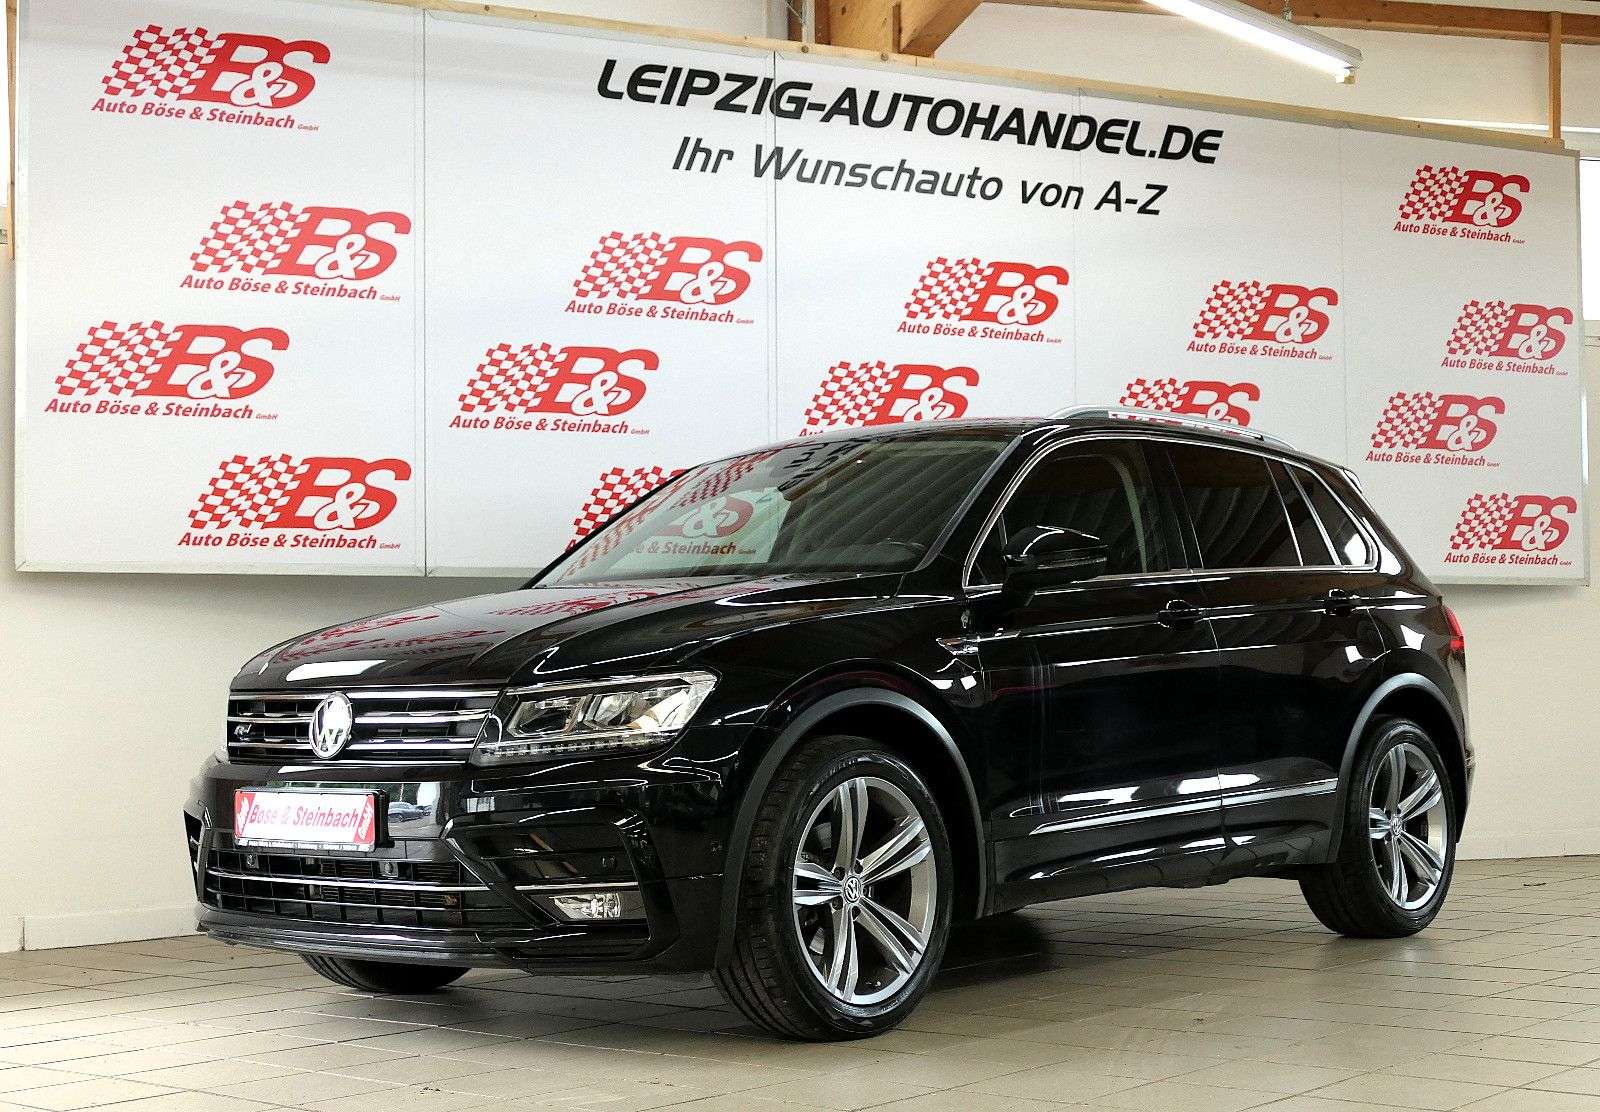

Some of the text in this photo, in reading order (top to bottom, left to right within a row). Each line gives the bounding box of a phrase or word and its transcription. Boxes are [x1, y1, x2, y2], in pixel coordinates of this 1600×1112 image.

[91, 98, 137, 113] Auto
[141, 102, 185, 118] Böse
[189, 107, 203, 120] &
[207, 108, 295, 128] Steinbach
[596, 59, 1223, 165] LEIPZIG-AUTOHANDEL.DE
[672, 136, 1168, 215] Ihr Wunschauto von A-Z
[1393, 221, 1420, 233] Auto
[1422, 224, 1448, 236] Böse
[1449, 227, 1458, 237] &
[1460, 228, 1511, 242] Steinbach
[180, 275, 224, 289] Auto
[228, 278, 271, 292] Böse
[275, 281, 288, 293] &
[292, 282, 377, 300] Steinbach
[565, 300, 603, 314] Auto
[606, 303, 643, 316] Böse
[646, 306, 658, 318] &
[661, 307, 734, 323] Steinbach
[897, 321, 930, 334] Auto
[933, 323, 965, 336] Böse
[968, 326, 978, 337] &
[980, 327, 1044, 342] Steinbach
[1187, 341, 1216, 352] Auto
[1219, 343, 1247, 354] Böse
[1249, 345, 1258, 355] &
[1261, 345, 1317, 359] Steinbach
[1441, 357, 1467, 368] Auto
[1469, 359, 1494, 370] Böse
[1496, 361, 1503, 370] &
[1506, 362, 1555, 374] Steinbach
[44, 399, 91, 413] Auto
[95, 400, 141, 415] Böse
[145, 402, 160, 416] &
[162, 403, 253, 419] Steinbach
[449, 415, 489, 428] Auto
[493, 416, 532, 430] Böse
[535, 418, 548, 431] &
[551, 419, 628, 433] Steinbach
[1366, 451, 1393, 462] Auto
[1395, 452, 1421, 463] Böse
[1423, 453, 1432, 464] &
[1433, 454, 1485, 466] Steinbach
[177, 532, 223, 546] Auto
[226, 533, 269, 547] Böse
[273, 534, 287, 547] &
[290, 534, 377, 548] Steinbach
[662, 542, 737, 555] Steinbach
[1444, 552, 1469, 563] Auto
[1472, 553, 1496, 563] Böse
[1499, 554, 1506, 564] &
[1508, 554, 1558, 565] Steinbach
[293, 806, 359, 828] Steinbach
